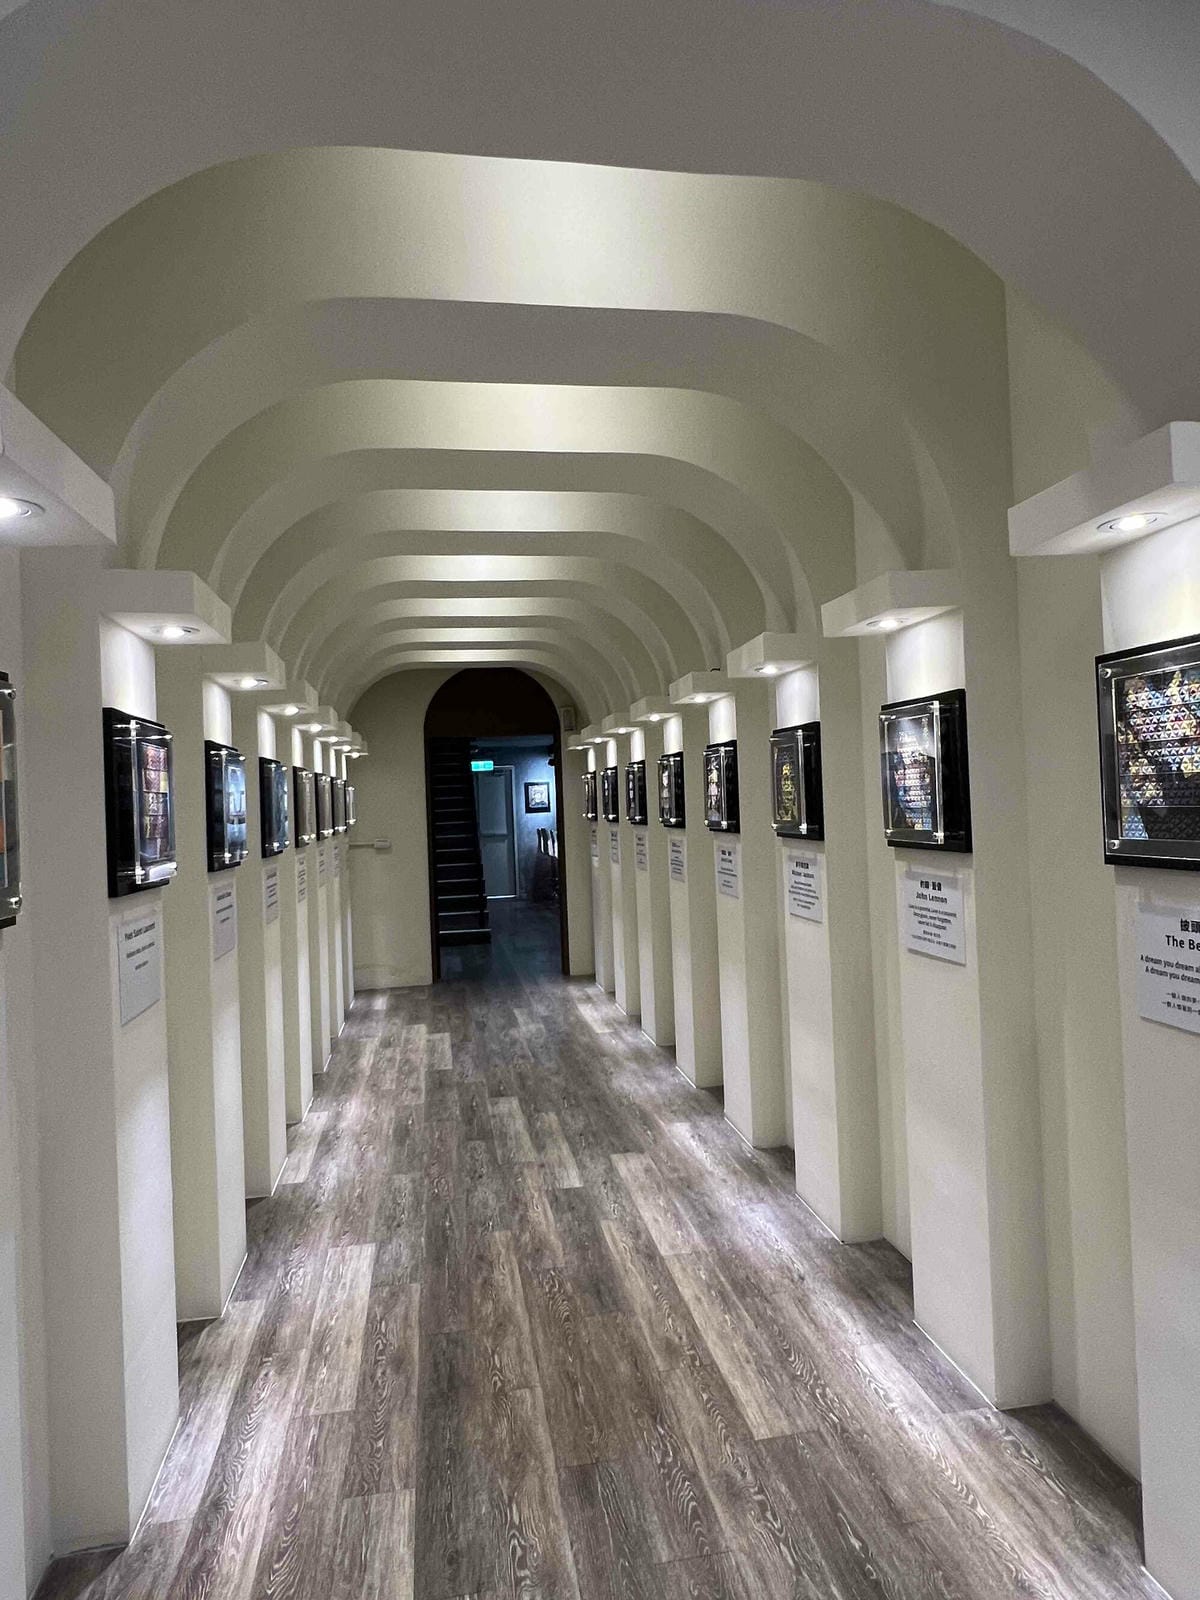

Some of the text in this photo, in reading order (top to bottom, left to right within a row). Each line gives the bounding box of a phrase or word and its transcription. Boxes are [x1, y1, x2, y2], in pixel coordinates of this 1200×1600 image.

[1165, 934, 1200, 952] The Be
[1145, 955, 1162, 965] dream
[1163, 960, 1174, 968] you
[1175, 961, 1194, 972] dream
[1150, 966, 1168, 977] dream
[1169, 972, 1180, 980] you
